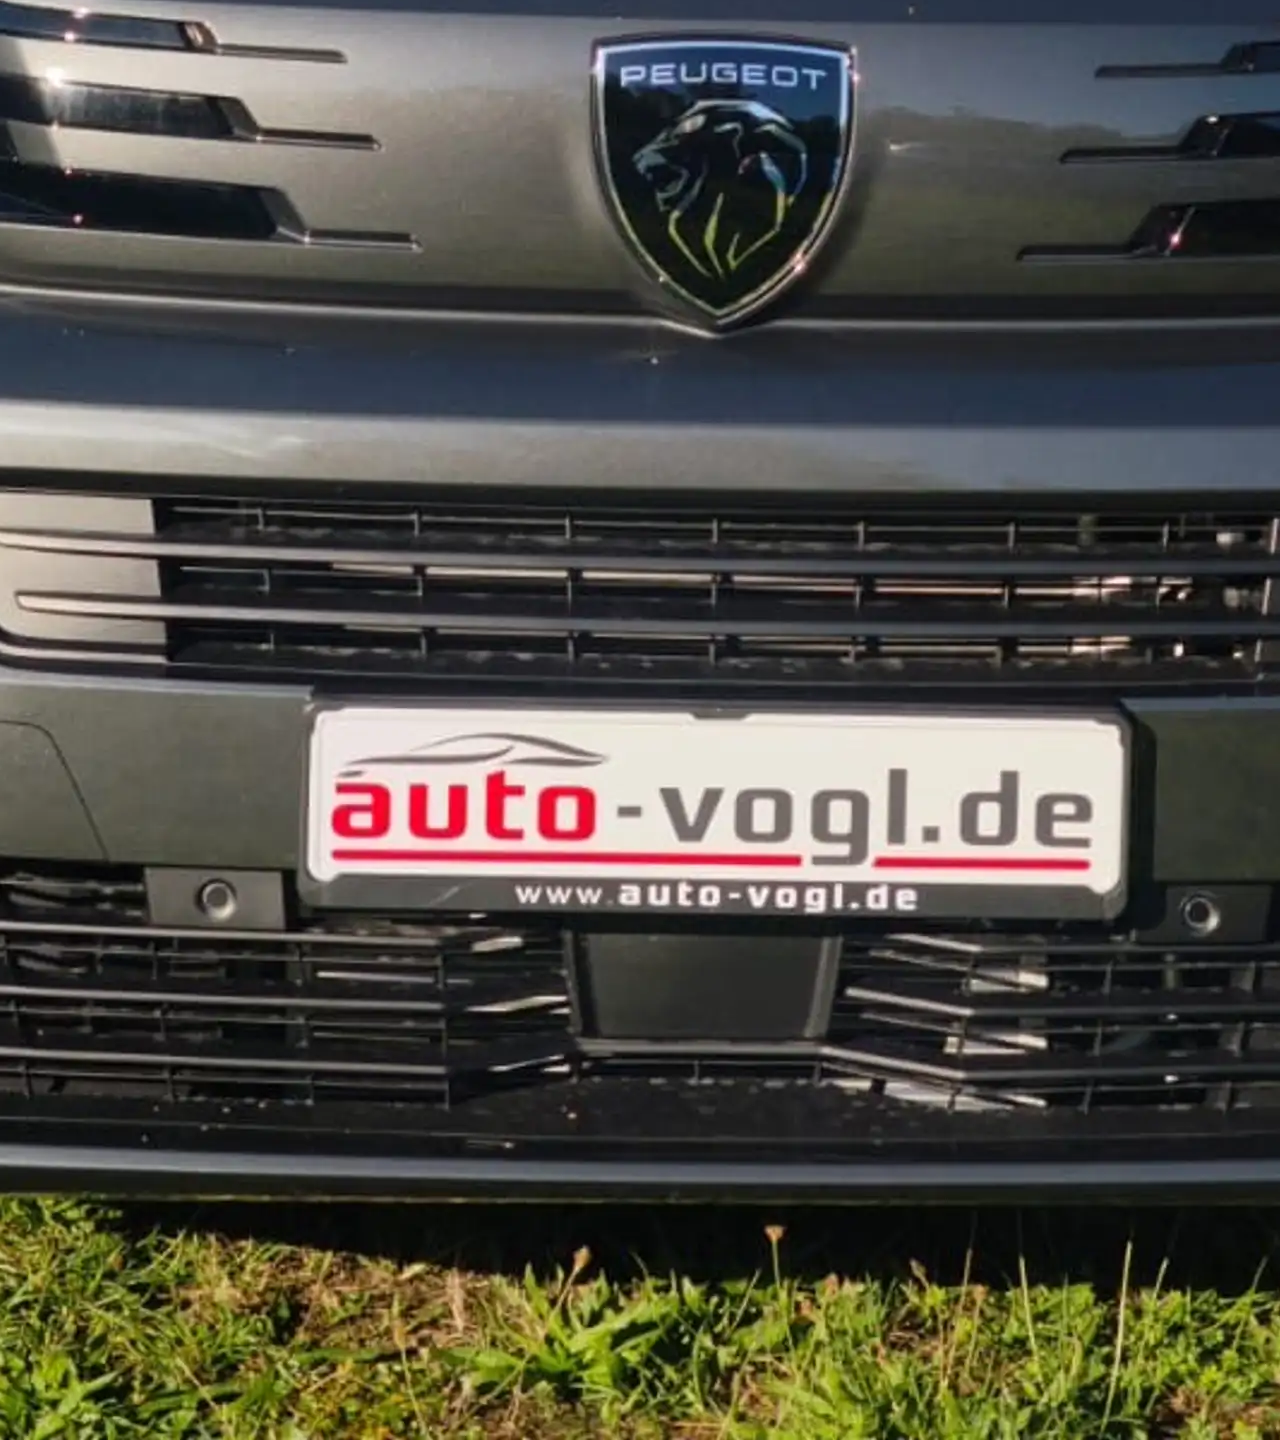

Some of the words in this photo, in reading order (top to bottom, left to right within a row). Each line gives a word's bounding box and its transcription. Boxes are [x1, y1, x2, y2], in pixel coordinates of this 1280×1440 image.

[620, 61, 827, 91] PEUGEOT
[329, 767, 1095, 867] auto-vogl.de
[513, 878, 919, 914] www.auto-vogl.de
